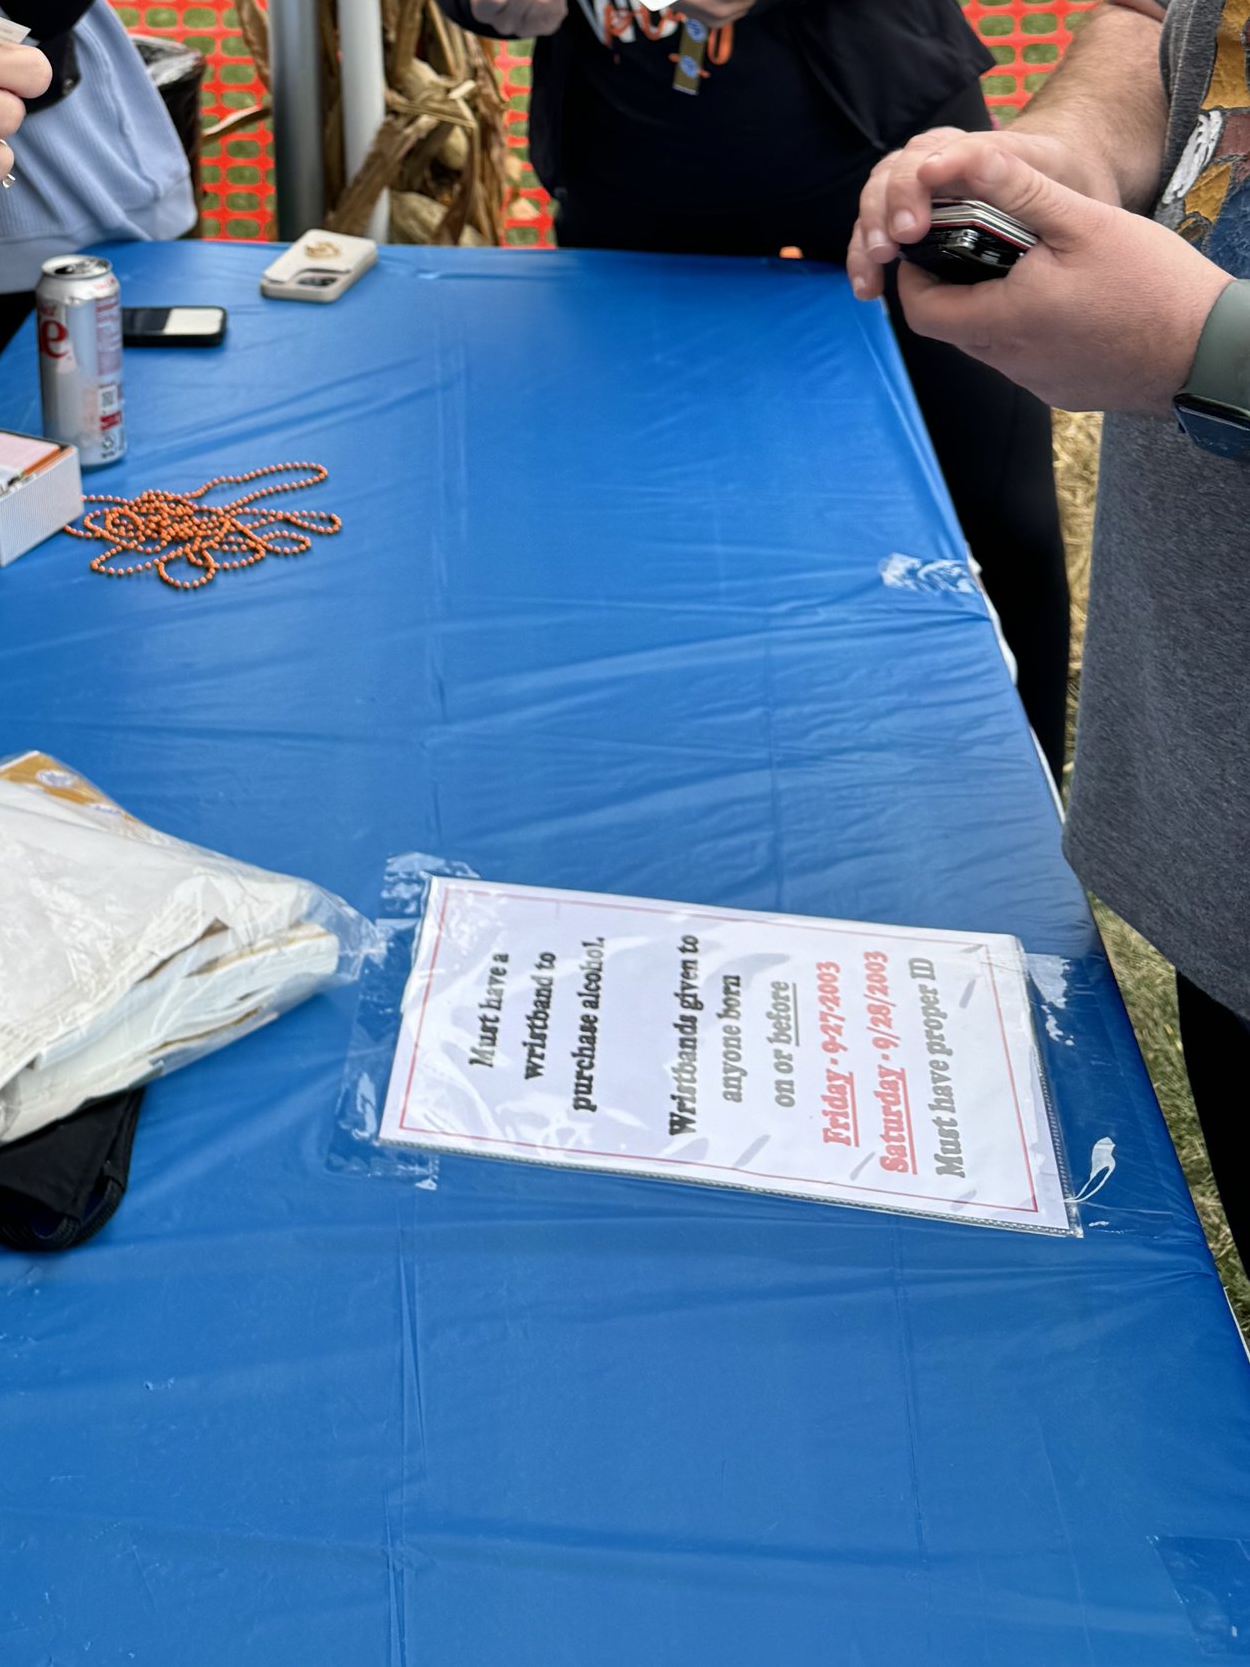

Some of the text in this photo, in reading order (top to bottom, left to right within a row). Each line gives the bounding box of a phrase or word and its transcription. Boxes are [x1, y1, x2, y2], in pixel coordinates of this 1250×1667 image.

[468, 952, 510, 1068] Must have a
[522, 951, 557, 1080] wristband to
[571, 936, 606, 1112] purchase alcohol.
[669, 934, 705, 1136] Wristbands given to
[716, 974, 748, 1103] anyone born
[766, 980, 796, 1108] on or before
[816, 960, 848, 1054] 9-27-2003
[863, 950, 901, 1050] 9/28/2003
[820, 1068, 855, 1147] Friday
[873, 1064, 912, 1174] Saturday
[908, 957, 966, 1179] Must have proper ID
